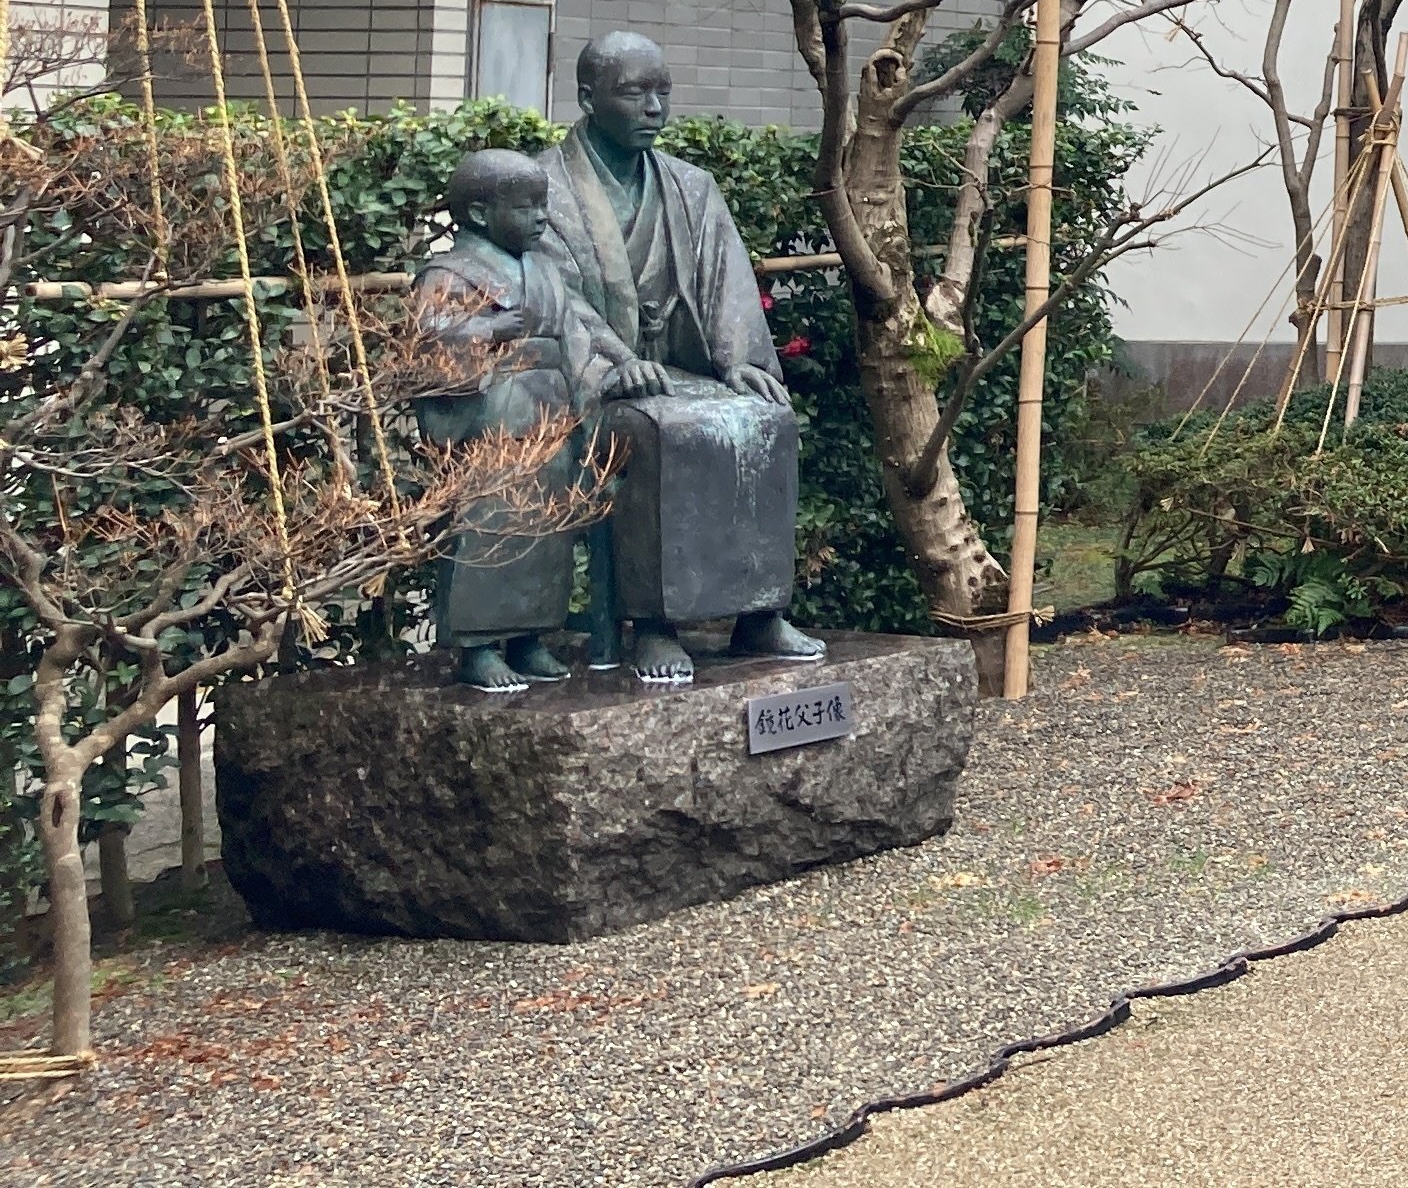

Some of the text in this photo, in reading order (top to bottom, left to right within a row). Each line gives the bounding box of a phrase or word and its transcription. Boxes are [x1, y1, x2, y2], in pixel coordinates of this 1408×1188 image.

[755, 695, 846, 735] 鏡花父子像
